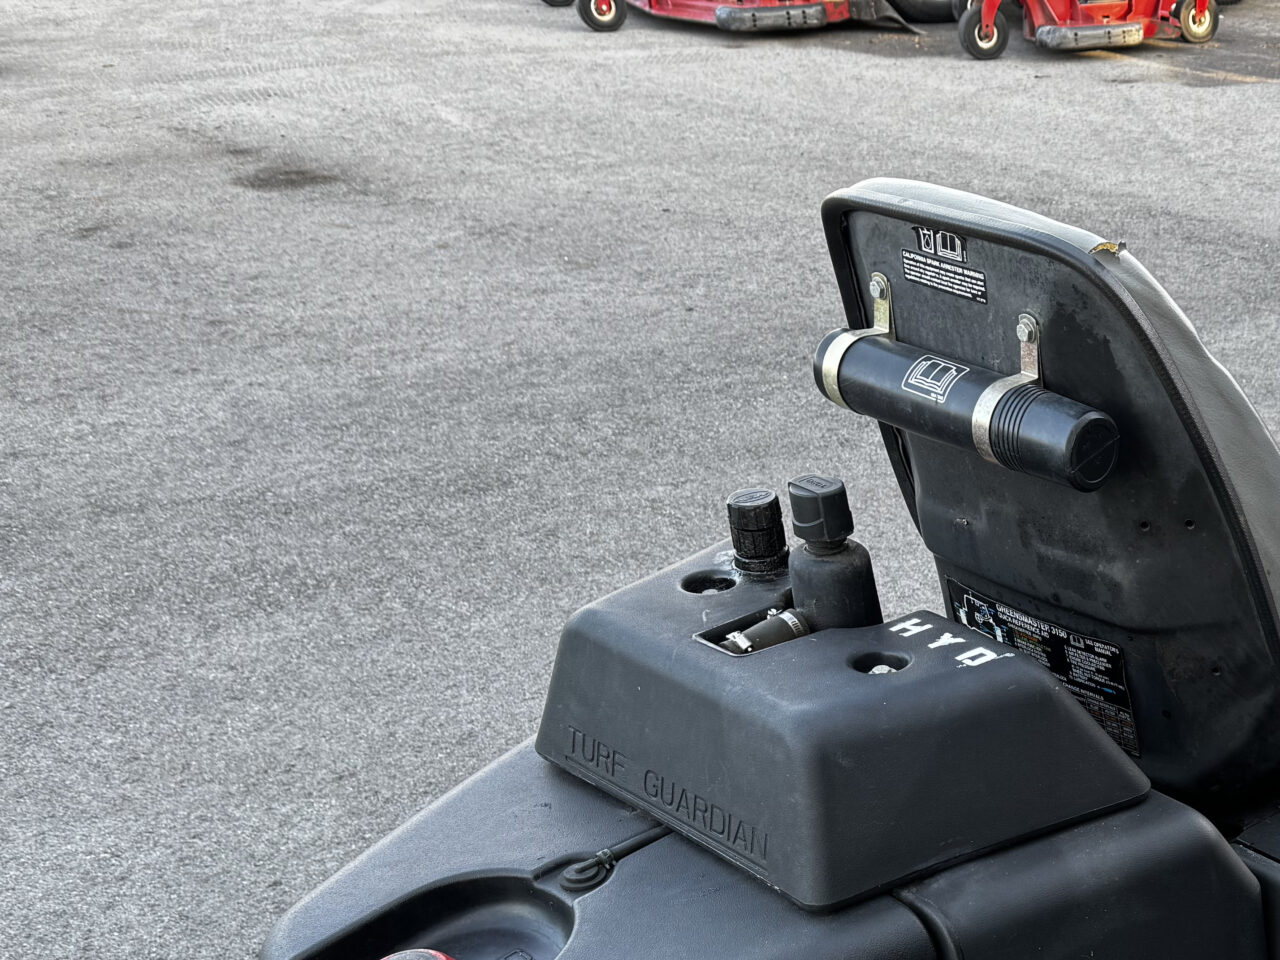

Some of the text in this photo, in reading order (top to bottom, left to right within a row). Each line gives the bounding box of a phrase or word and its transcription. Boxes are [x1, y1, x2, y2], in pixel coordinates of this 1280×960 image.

[889, 617, 998, 667] HYD
[1051, 626, 1068, 639] 3150
[568, 725, 768, 860] TURF GUARDIAN
